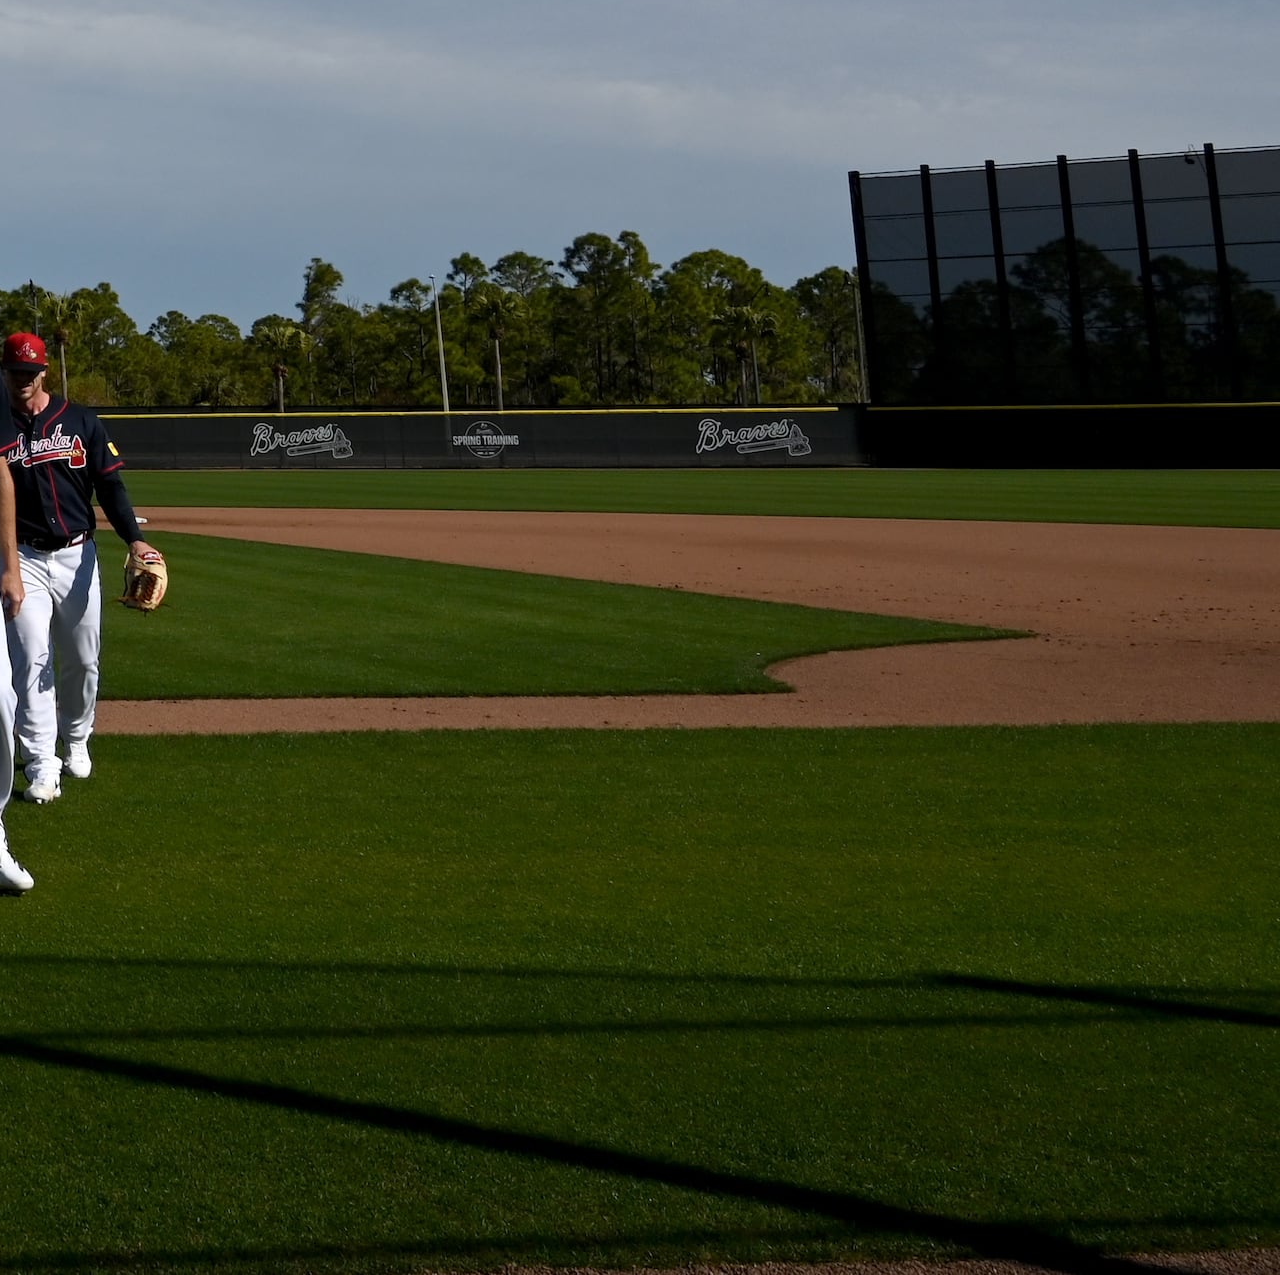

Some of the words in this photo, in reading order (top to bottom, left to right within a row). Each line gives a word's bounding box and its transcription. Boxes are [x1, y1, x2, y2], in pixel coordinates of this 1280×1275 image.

[250, 423, 334, 457] Braves
[452, 435, 481, 446] SPRING
[482, 435, 520, 446] TRAINING
[695, 418, 790, 454] Braves
